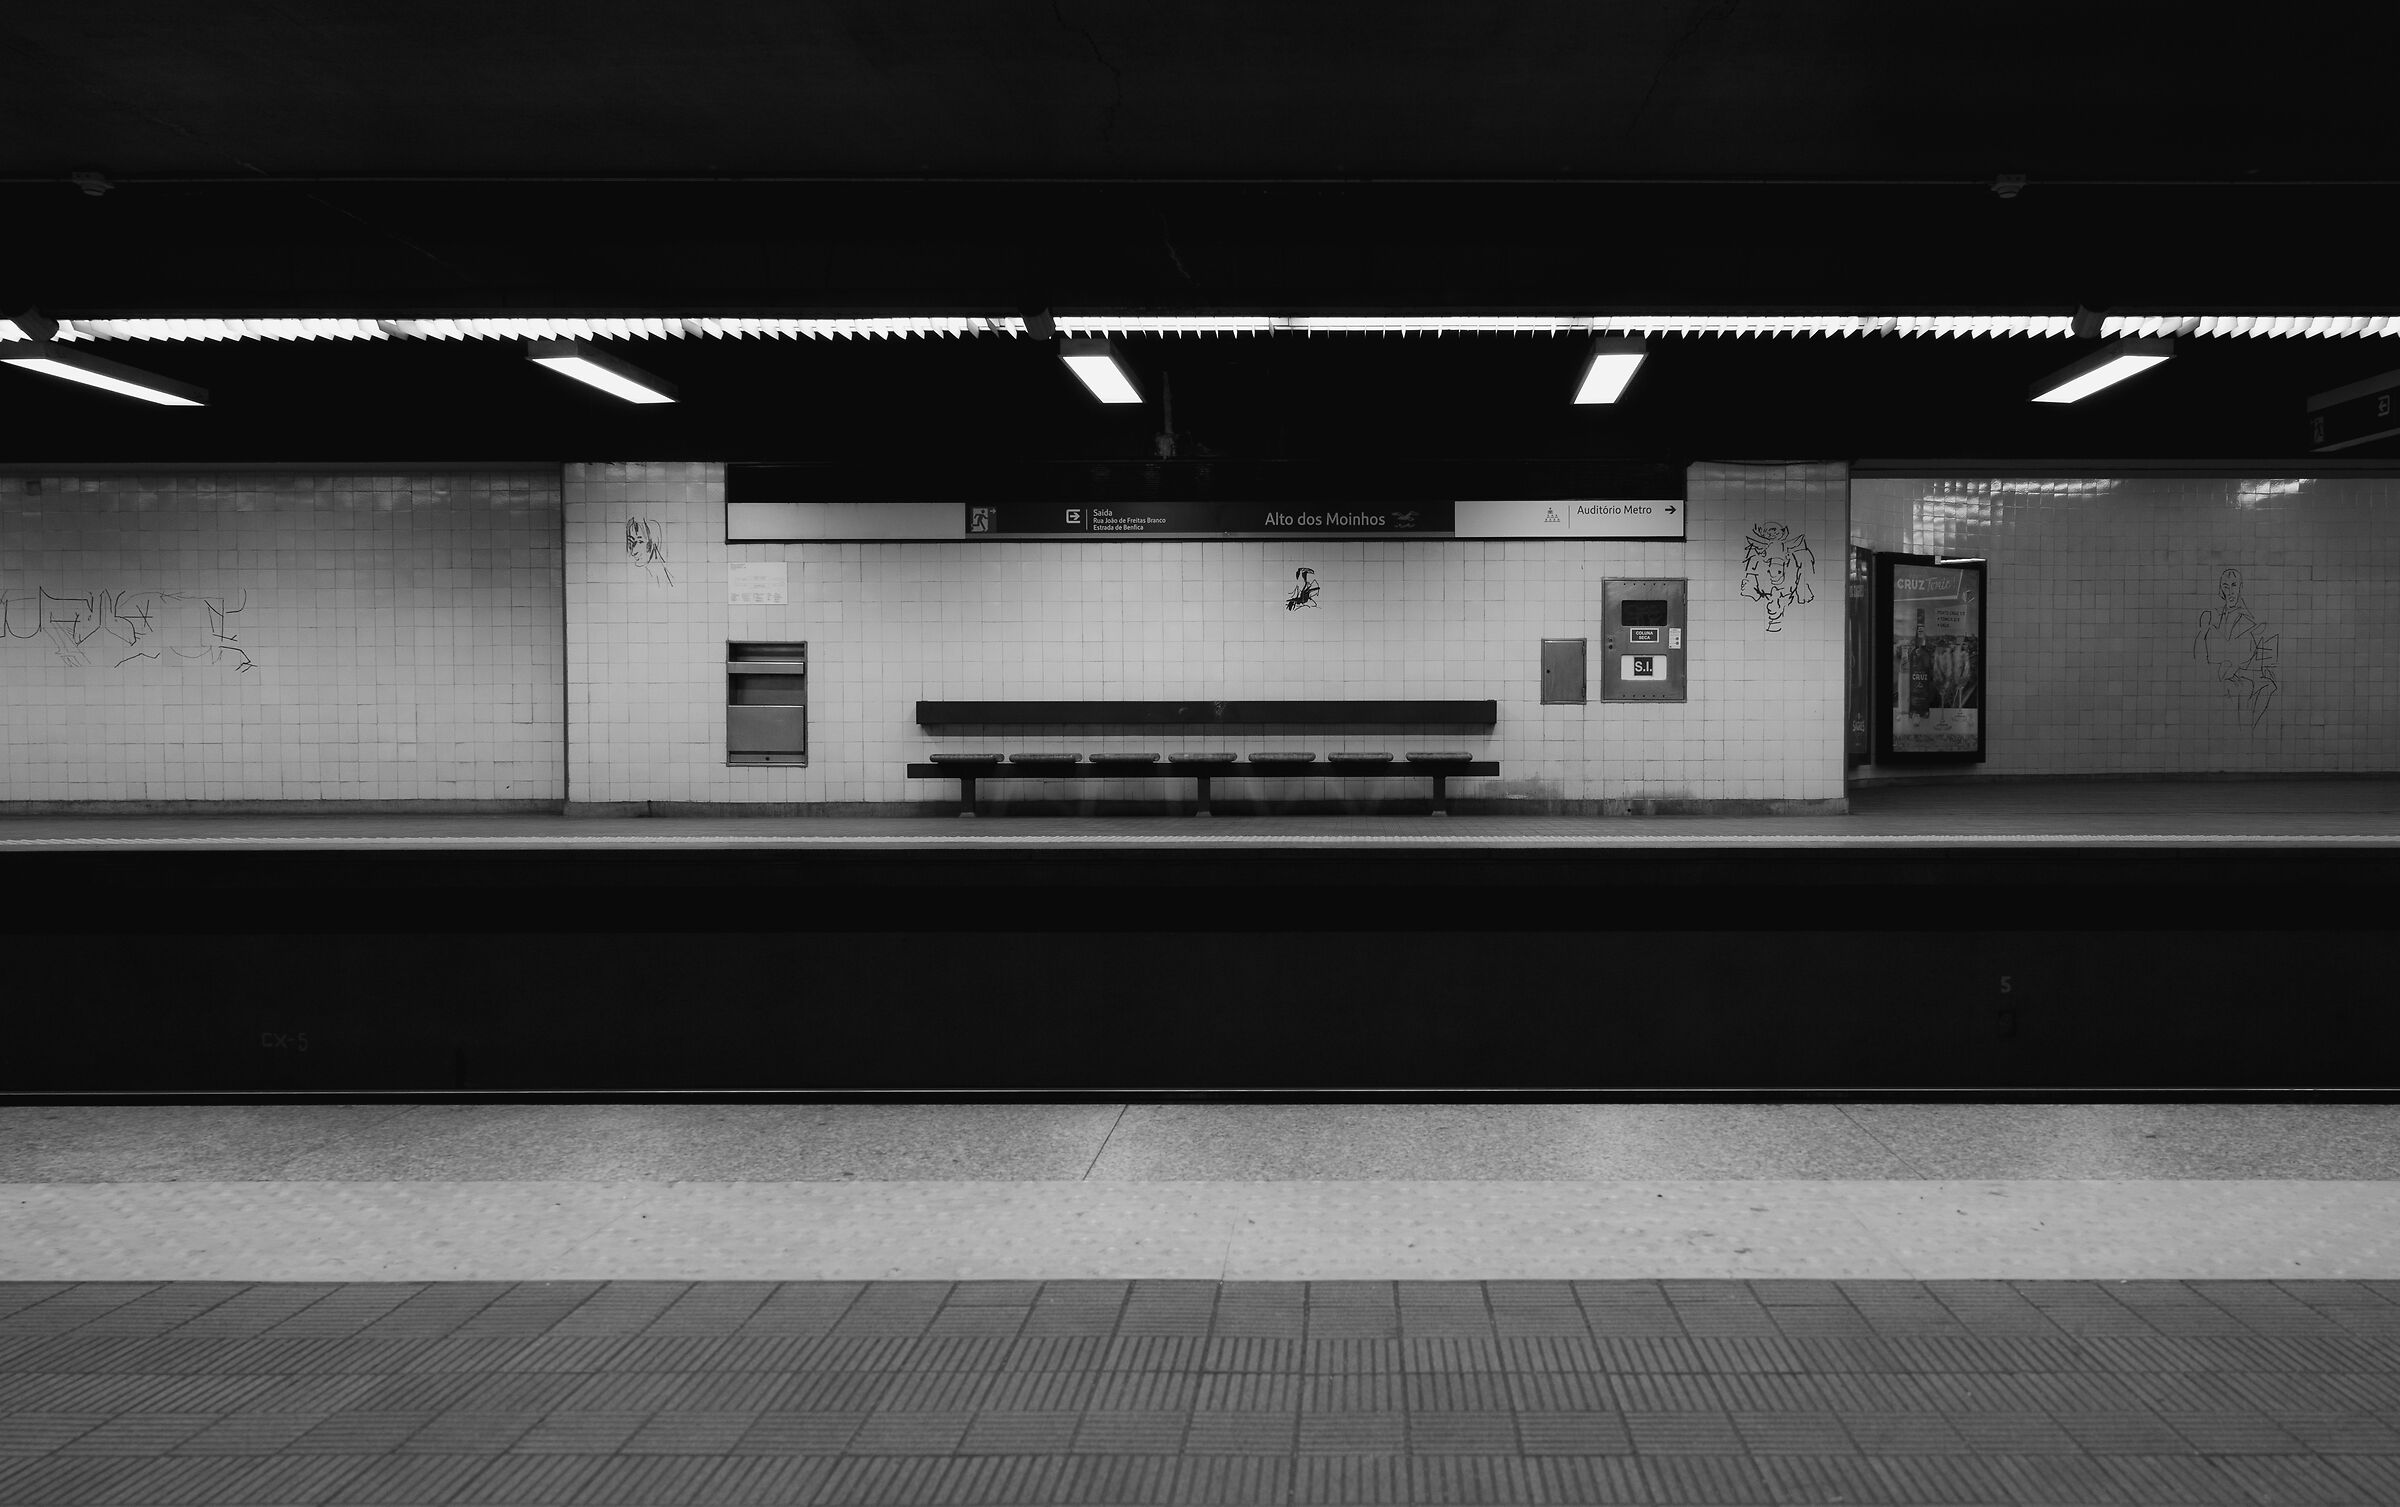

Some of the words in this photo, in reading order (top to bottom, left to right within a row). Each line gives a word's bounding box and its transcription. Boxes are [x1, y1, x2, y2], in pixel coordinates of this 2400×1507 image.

[1577, 505, 1621, 515] Auditório
[1624, 505, 1652, 515] Metro
[1265, 512, 1294, 526] Alto
[1297, 512, 1323, 526] dos
[1326, 512, 1386, 526] Moinhos
[1897, 578, 1925, 590] CRUZ
[1634, 661, 1653, 673] S.I.
